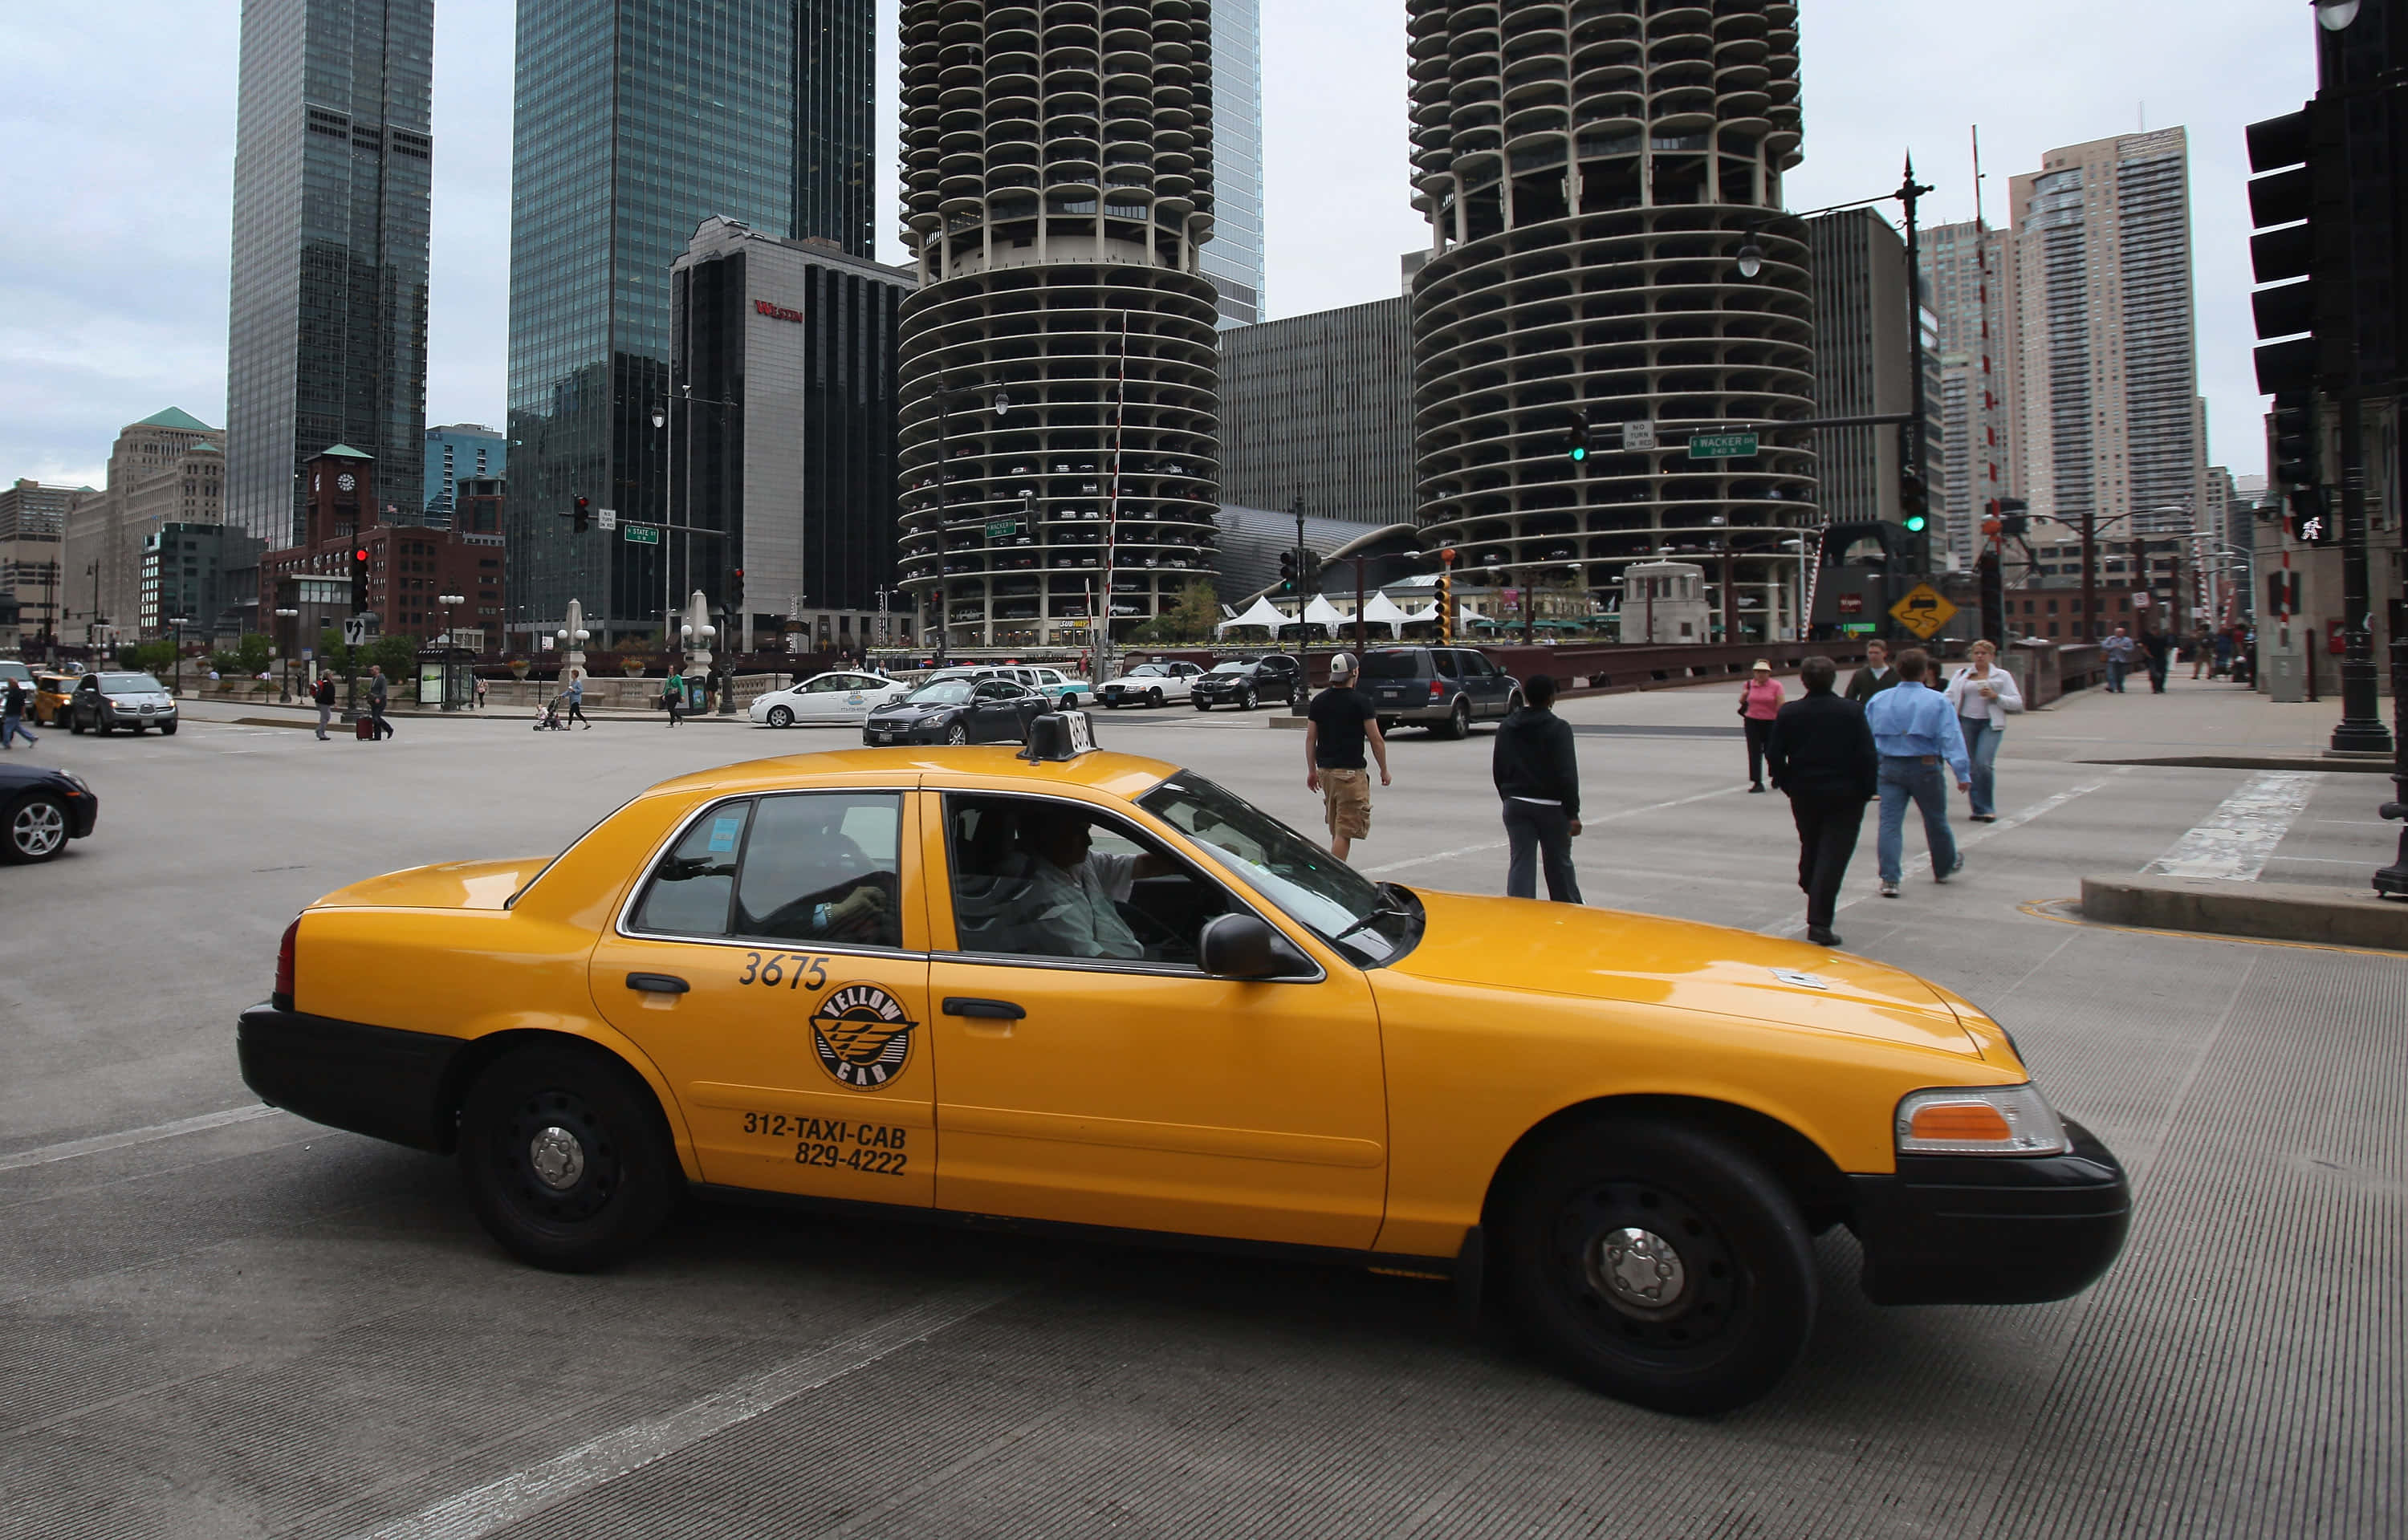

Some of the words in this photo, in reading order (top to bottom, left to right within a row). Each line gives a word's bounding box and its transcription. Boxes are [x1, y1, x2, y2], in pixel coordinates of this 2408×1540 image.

[755, 299, 803, 323] WESTIN
[1701, 437, 1742, 448] WACKER
[633, 528, 649, 536] STATE
[990, 522, 1009, 530] WACKER
[1060, 620, 1088, 628] SUBWAY
[1069, 716, 1089, 750] 3675
[739, 952, 830, 991] 3675
[823, 986, 901, 1021] YELLOW
[836, 1061, 887, 1086] CAB
[743, 1112, 906, 1150] 312-TAXI-CAB
[795, 1142, 908, 1176] 829-4222
